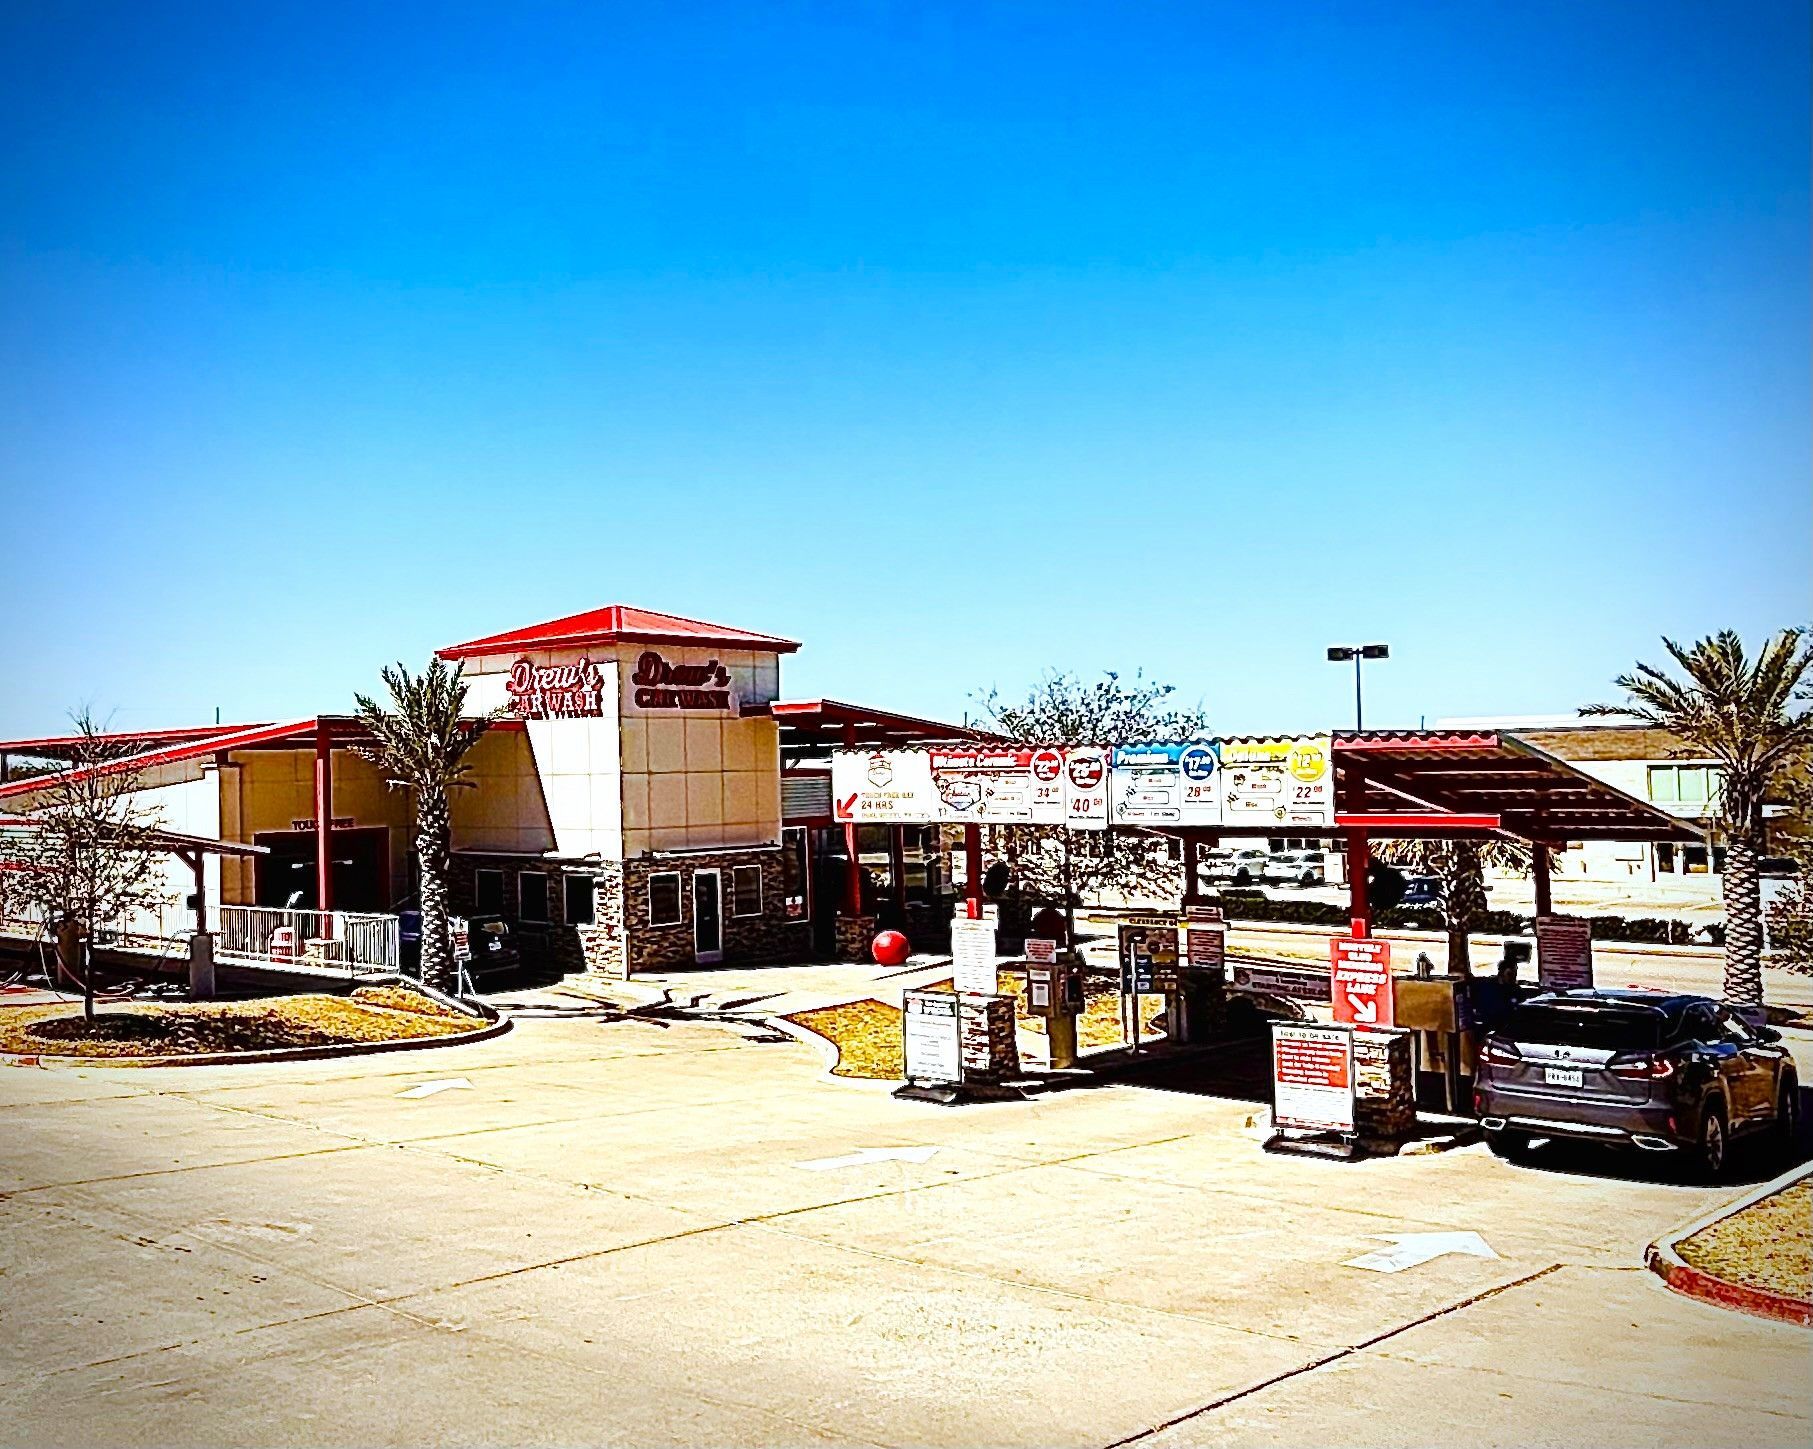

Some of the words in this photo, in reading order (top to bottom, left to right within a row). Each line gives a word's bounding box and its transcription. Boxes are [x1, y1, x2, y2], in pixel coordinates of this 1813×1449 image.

[506, 657, 604, 693] Drew's
[545, 690, 602, 716] WASH
[1296, 786, 1311, 798] 22
[861, 801, 872, 810] 24
[1073, 798, 1090, 812] 40
